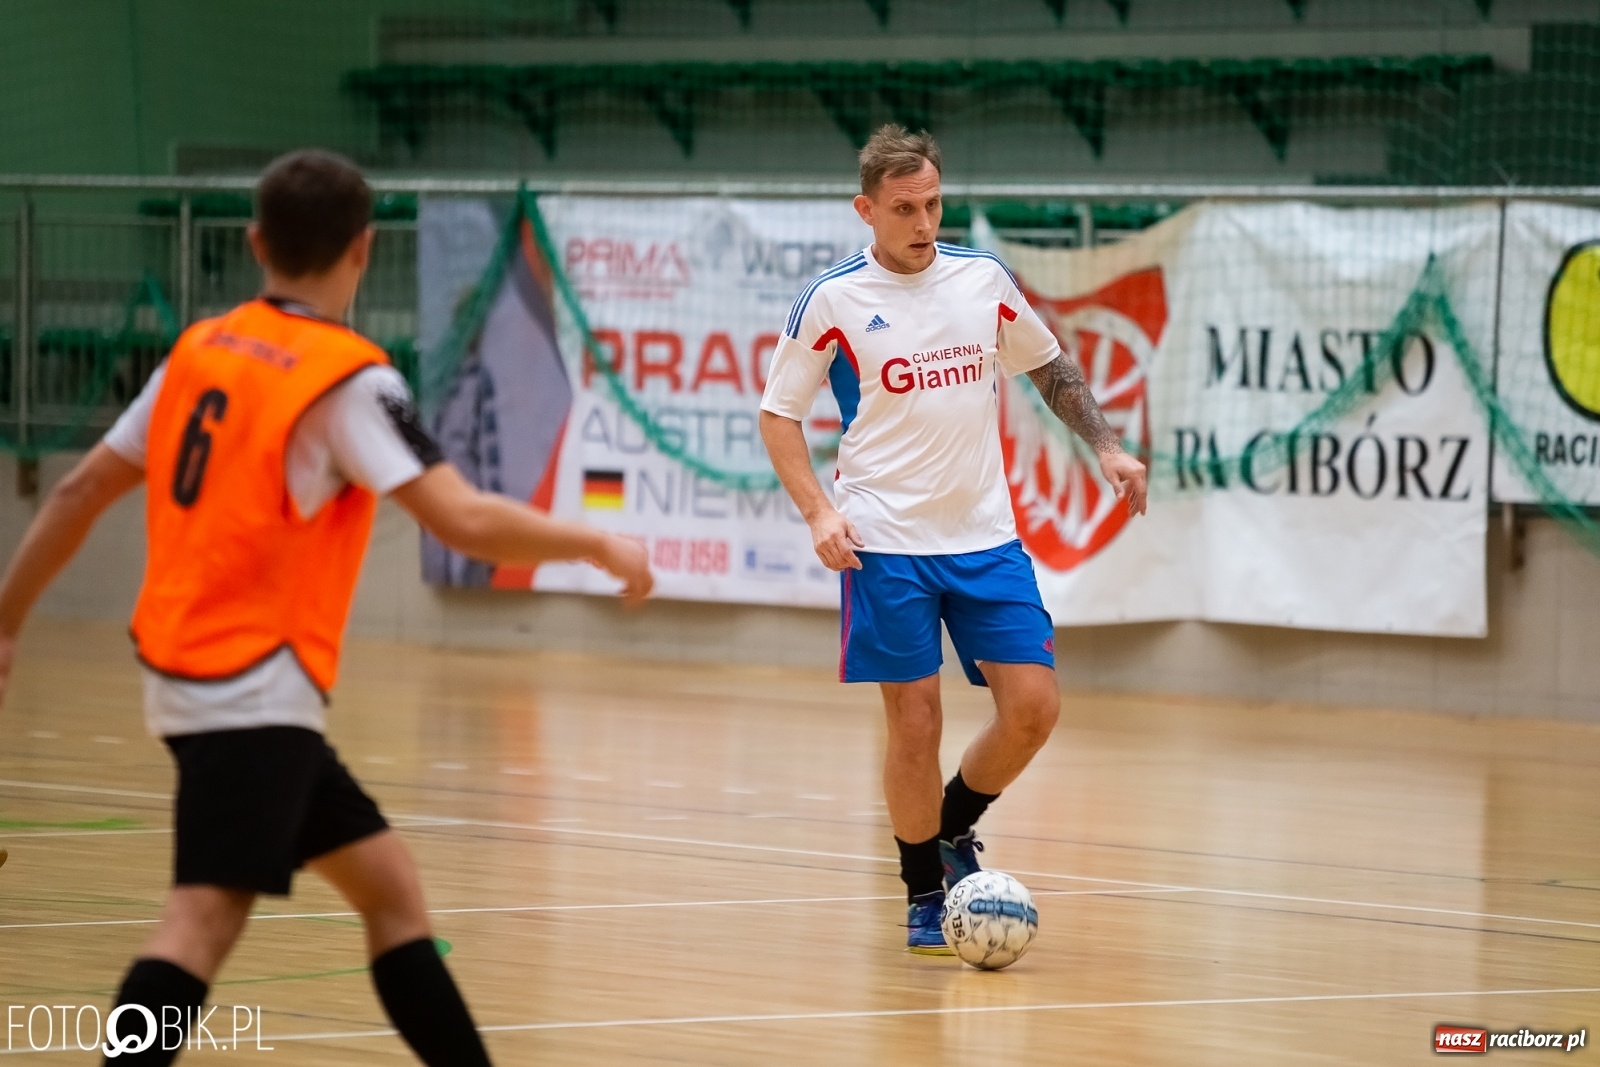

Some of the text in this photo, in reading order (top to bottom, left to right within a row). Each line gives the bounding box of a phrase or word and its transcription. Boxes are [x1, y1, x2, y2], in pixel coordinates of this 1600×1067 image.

[738, 237, 856, 280] WOR
[865, 323, 890, 332] adidas
[912, 343, 983, 364] CUKIERNIA
[1204, 325, 1436, 397] MIASTO
[880, 356, 984, 394] Gianni
[172, 387, 229, 510] 6
[1173, 414, 1473, 502] RACIBÓRZ
[1534, 431, 1600, 467] RACI
